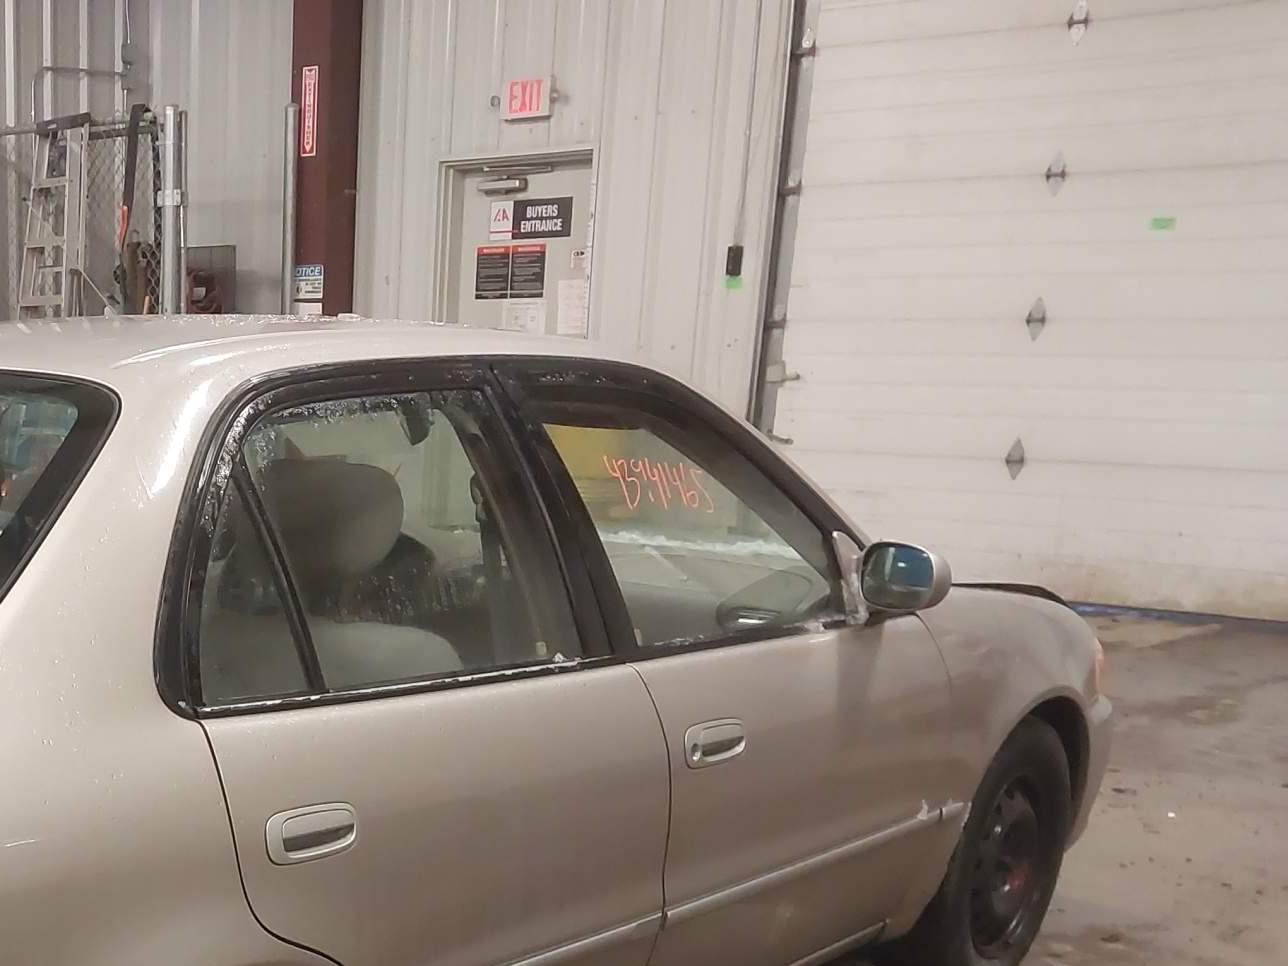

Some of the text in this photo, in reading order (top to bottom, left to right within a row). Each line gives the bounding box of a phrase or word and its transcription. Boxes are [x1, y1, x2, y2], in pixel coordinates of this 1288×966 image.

[508, 79, 543, 113] EXIT
[526, 204, 559, 218] BUYERS
[520, 218, 563, 233] ENTRANCE
[295, 266, 321, 277] OTICE
